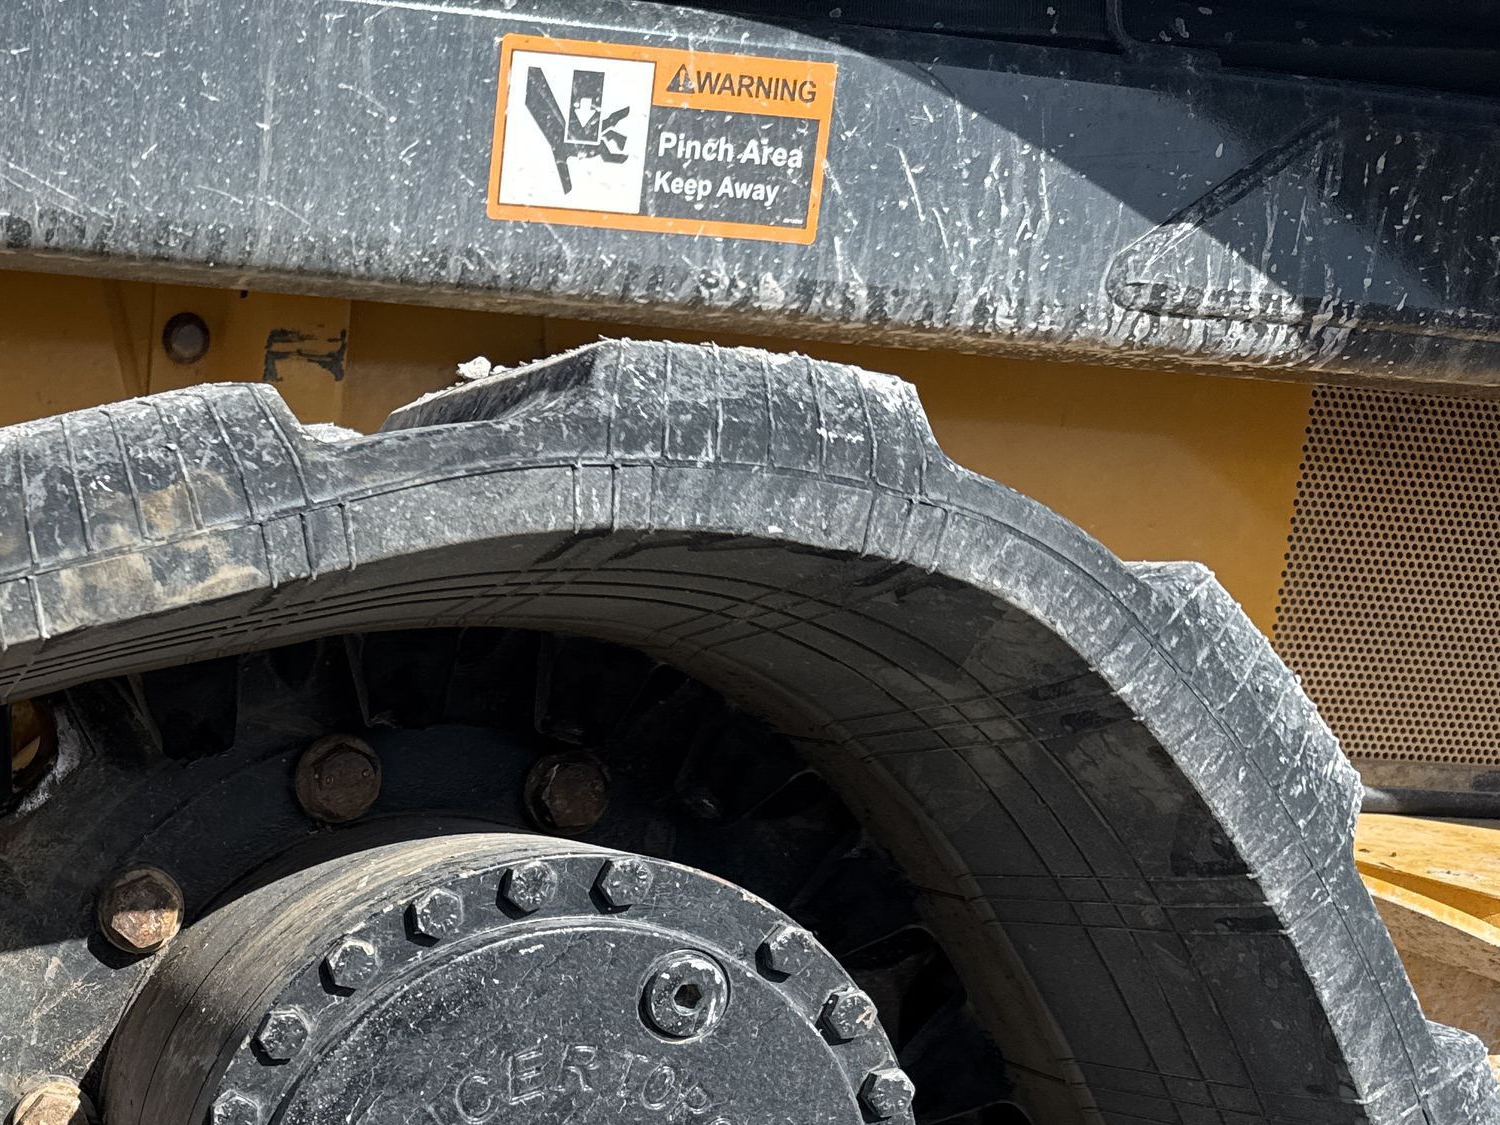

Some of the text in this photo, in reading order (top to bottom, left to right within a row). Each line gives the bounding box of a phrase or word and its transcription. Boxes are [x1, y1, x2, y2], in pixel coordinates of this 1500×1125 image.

[696, 70, 817, 104] WARNING
[657, 131, 804, 169] Pinch Area
[653, 170, 780, 207] Keep Away
